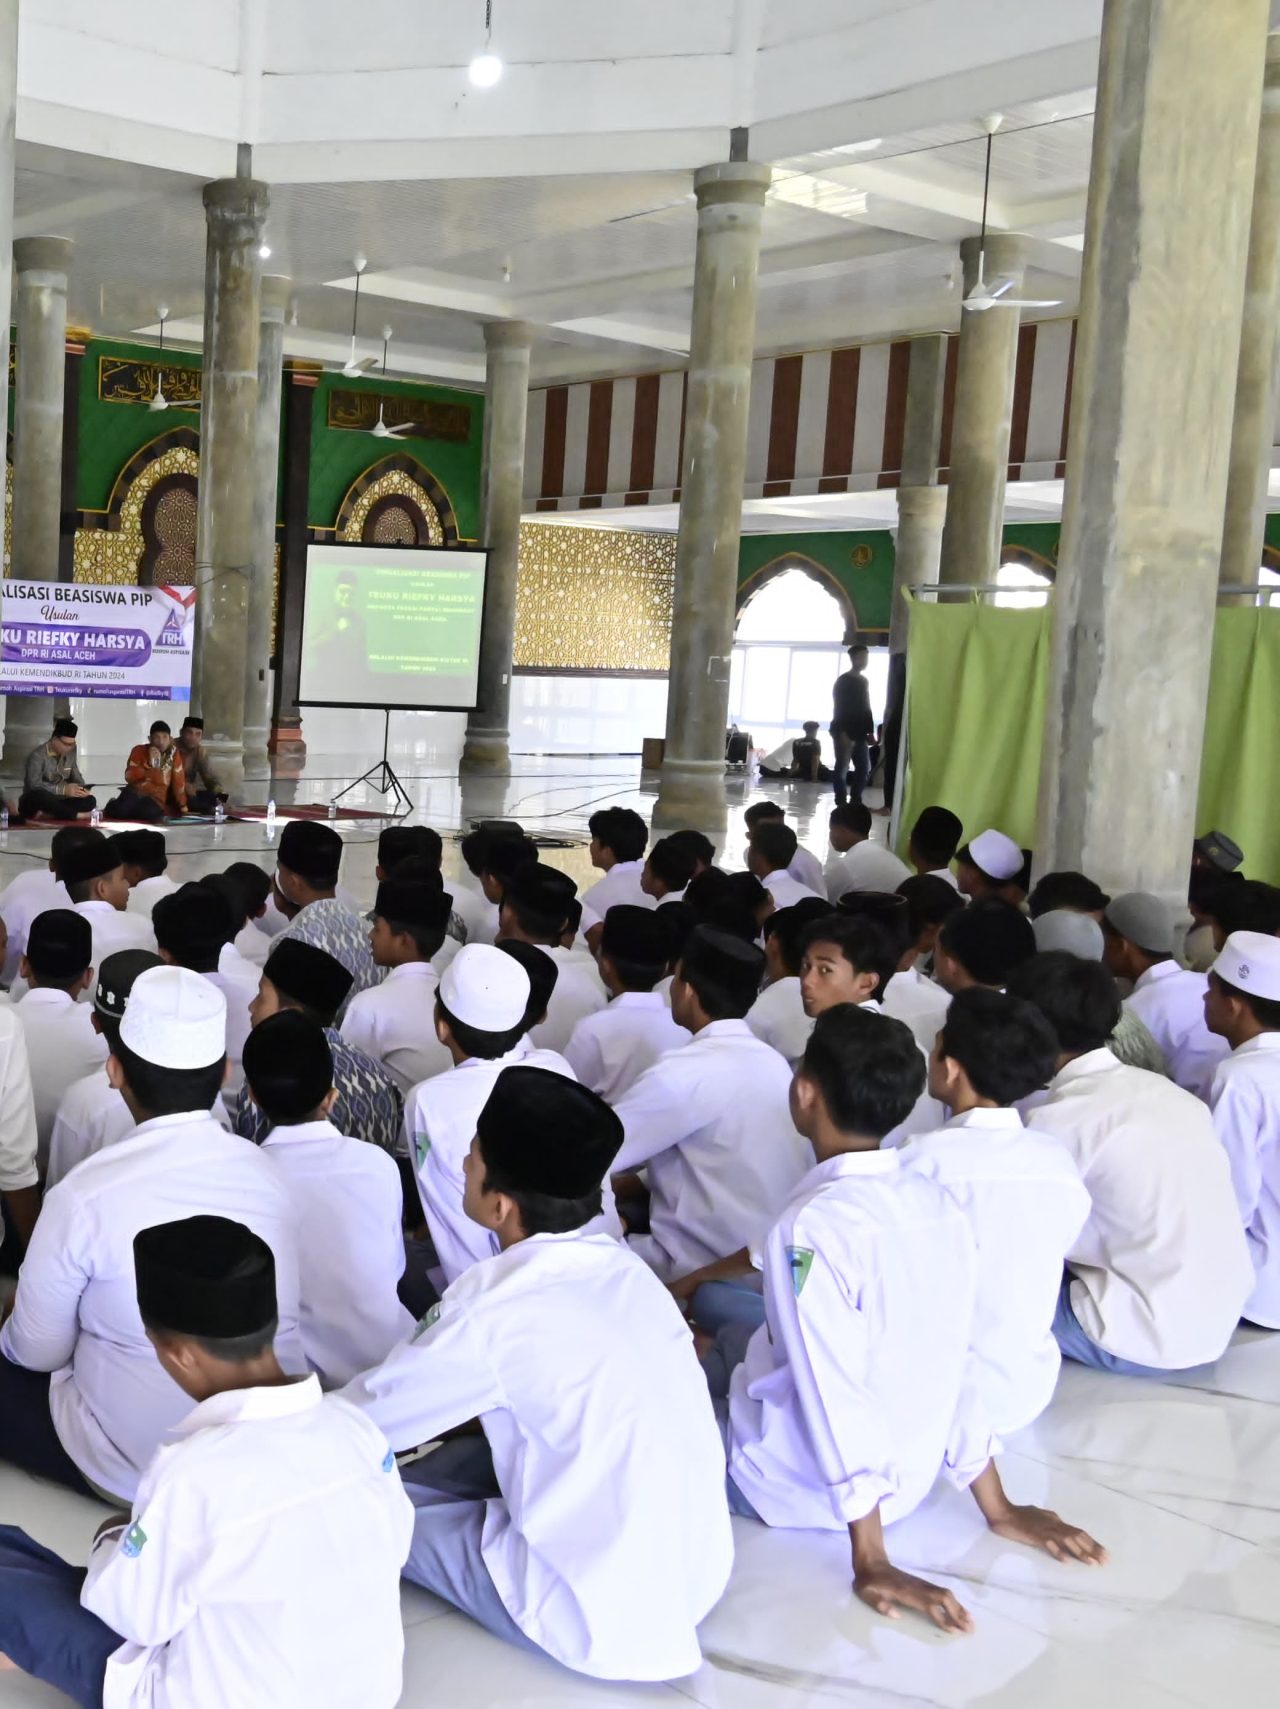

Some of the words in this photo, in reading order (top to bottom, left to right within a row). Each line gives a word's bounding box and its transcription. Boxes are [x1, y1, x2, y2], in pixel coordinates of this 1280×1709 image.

[54, 588, 127, 605] BEASISWA
[131, 593, 153, 606] PIP
[41, 605, 80, 621] Usulan
[26, 630, 80, 647] RIEFKY
[84, 633, 145, 650] HARSYA
[162, 632, 183, 645] TRH
[21, 648, 38, 658] DPR
[40, 649, 49, 658] RI
[51, 650, 72, 660] ASAL
[74, 651, 96, 660] ACEH
[20, 668, 72, 678] KEMENDIKBUD
[74, 670, 81, 678] RI
[83, 670, 107, 679] TAHUN
[109, 671, 125, 680] 2024
